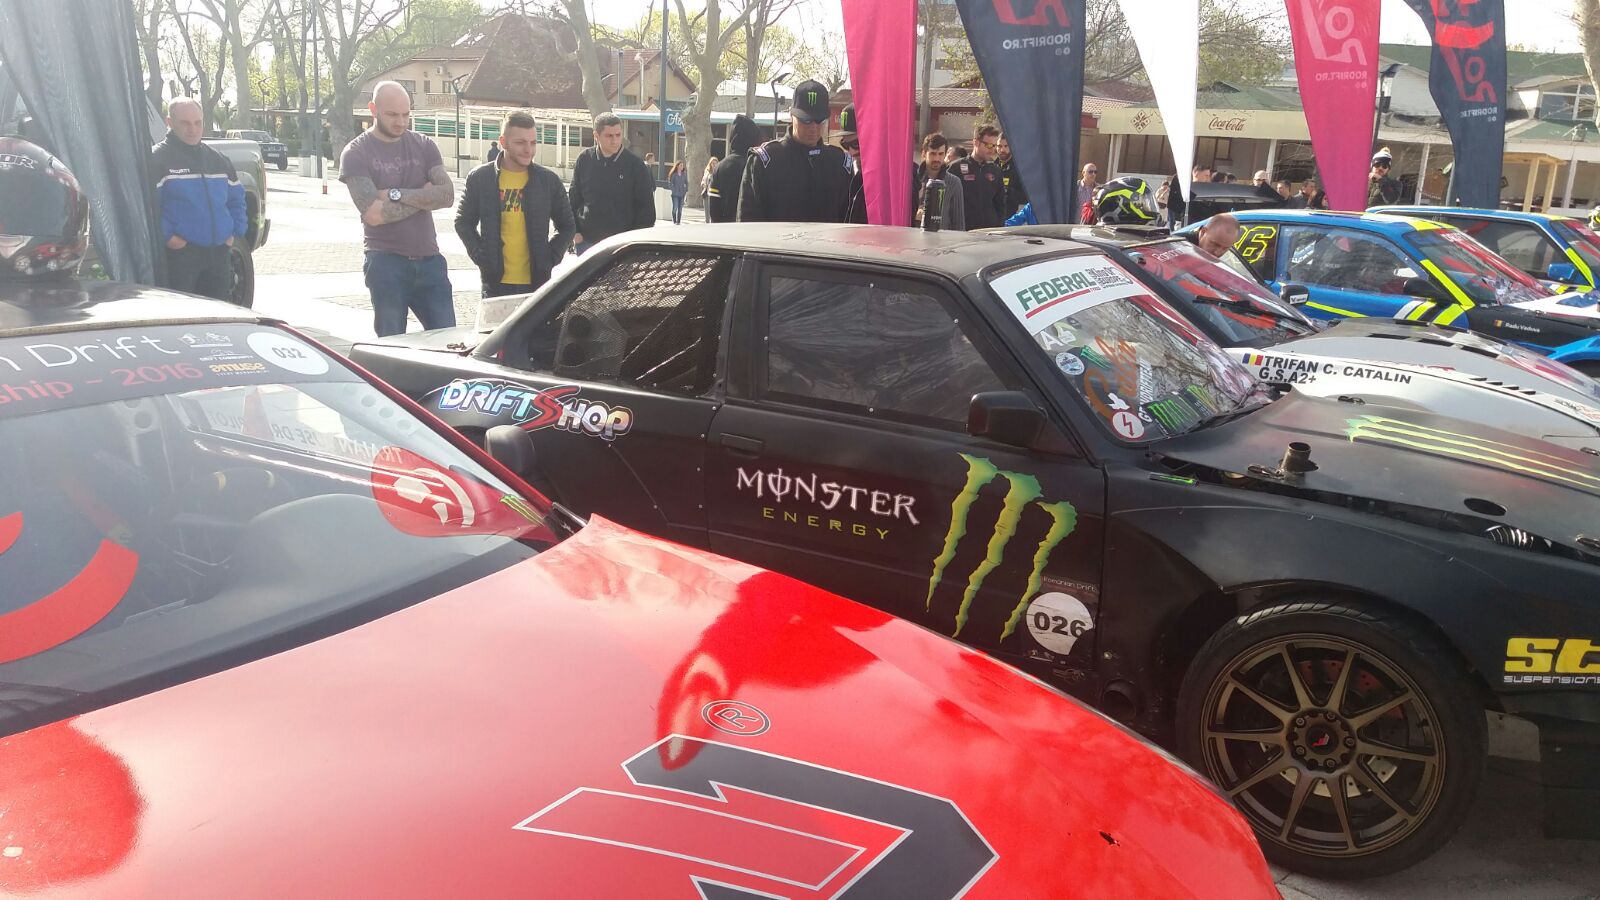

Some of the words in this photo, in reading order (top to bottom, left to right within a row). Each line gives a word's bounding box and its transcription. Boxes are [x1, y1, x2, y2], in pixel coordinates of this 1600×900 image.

[1016, 270, 1097, 311] FEDERAL
[25, 335, 181, 368] Drift
[272, 346, 307, 360] 032
[110, 362, 205, 386] 2016
[1264, 355, 1319, 373] TRIFAN
[1323, 363, 1338, 375] C.
[1343, 366, 1412, 385] CATALIN
[736, 466, 920, 526] MONSTER
[763, 507, 890, 541] ENERGY
[1033, 611, 1087, 638] 026
